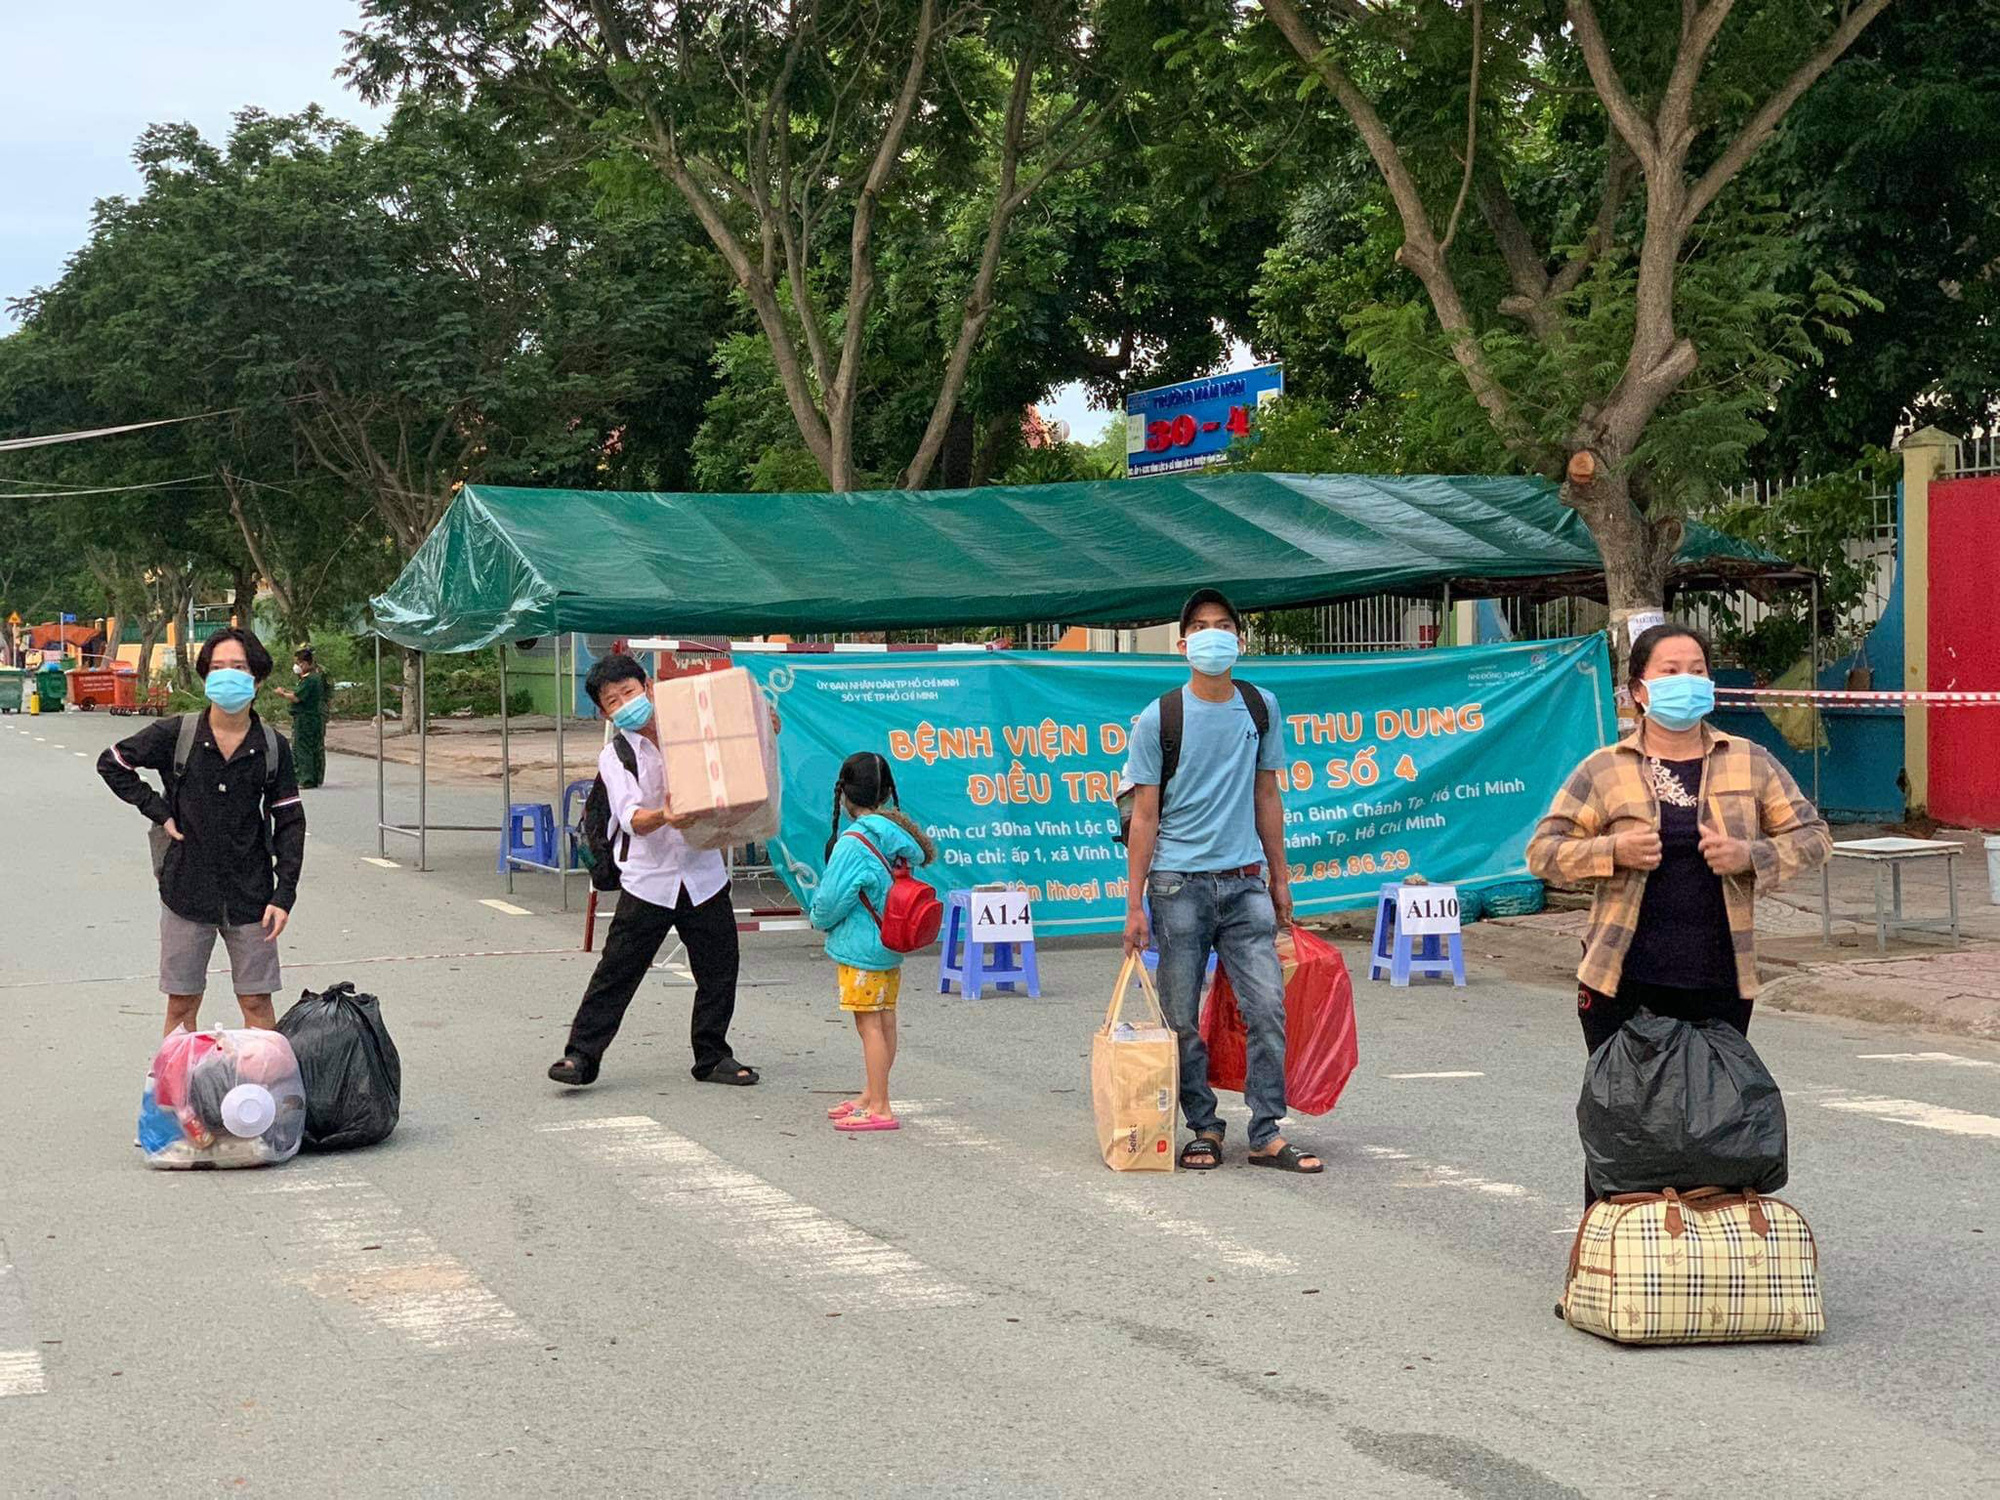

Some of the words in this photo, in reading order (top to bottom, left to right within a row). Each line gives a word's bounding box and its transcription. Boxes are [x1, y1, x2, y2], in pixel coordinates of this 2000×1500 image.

[1145, 413, 1198, 453] 30
[829, 681, 848, 690] BAN
[1287, 710, 1364, 746] THU
[1375, 702, 1485, 741] DUNG
[888, 720, 993, 766] BỆNH
[1003, 717, 1088, 763] VIỆN
[967, 759, 1051, 806] ĐIỀU
[1326, 746, 1380, 788] SỐ
[1394, 753, 1419, 782] 4
[1308, 805, 1348, 822] Bình
[1352, 799, 1403, 819] Chánh
[1454, 781, 1480, 800] Chí
[1485, 778, 1526, 796] Minh
[991, 821, 1032, 838] 30ha
[1034, 821, 1071, 837] Vĩnh
[1076, 819, 1103, 838] Lộc
[1326, 830, 1350, 847] Tp.
[1355, 822, 1375, 842] Hồ
[1379, 822, 1401, 837] Chí
[1405, 813, 1446, 832] Minh
[944, 847, 973, 867] Địa
[1011, 845, 1031, 866] ấp
[1051, 847, 1070, 862] xã
[1073, 845, 1111, 861] Vĩnh
[1046, 877, 1100, 904] thoại
[977, 903, 1031, 926] A1.4
[1406, 897, 1459, 919] A1.10
